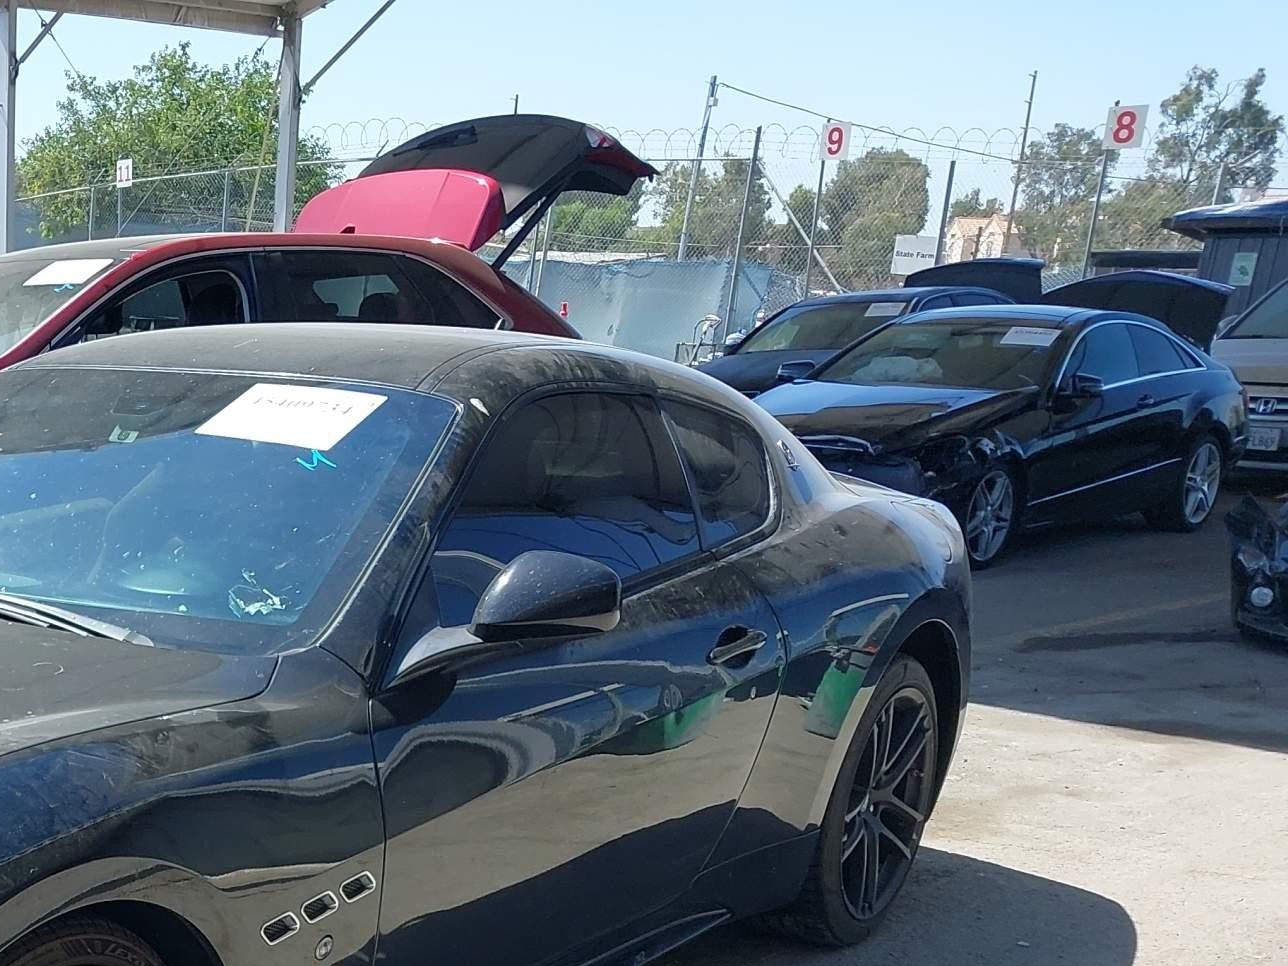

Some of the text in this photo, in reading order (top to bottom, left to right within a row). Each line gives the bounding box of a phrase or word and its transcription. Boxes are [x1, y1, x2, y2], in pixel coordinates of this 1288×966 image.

[1113, 111, 1137, 143] 8
[827, 127, 843, 155] 9
[117, 165, 131, 182] 11
[895, 250, 934, 259] State Farm
